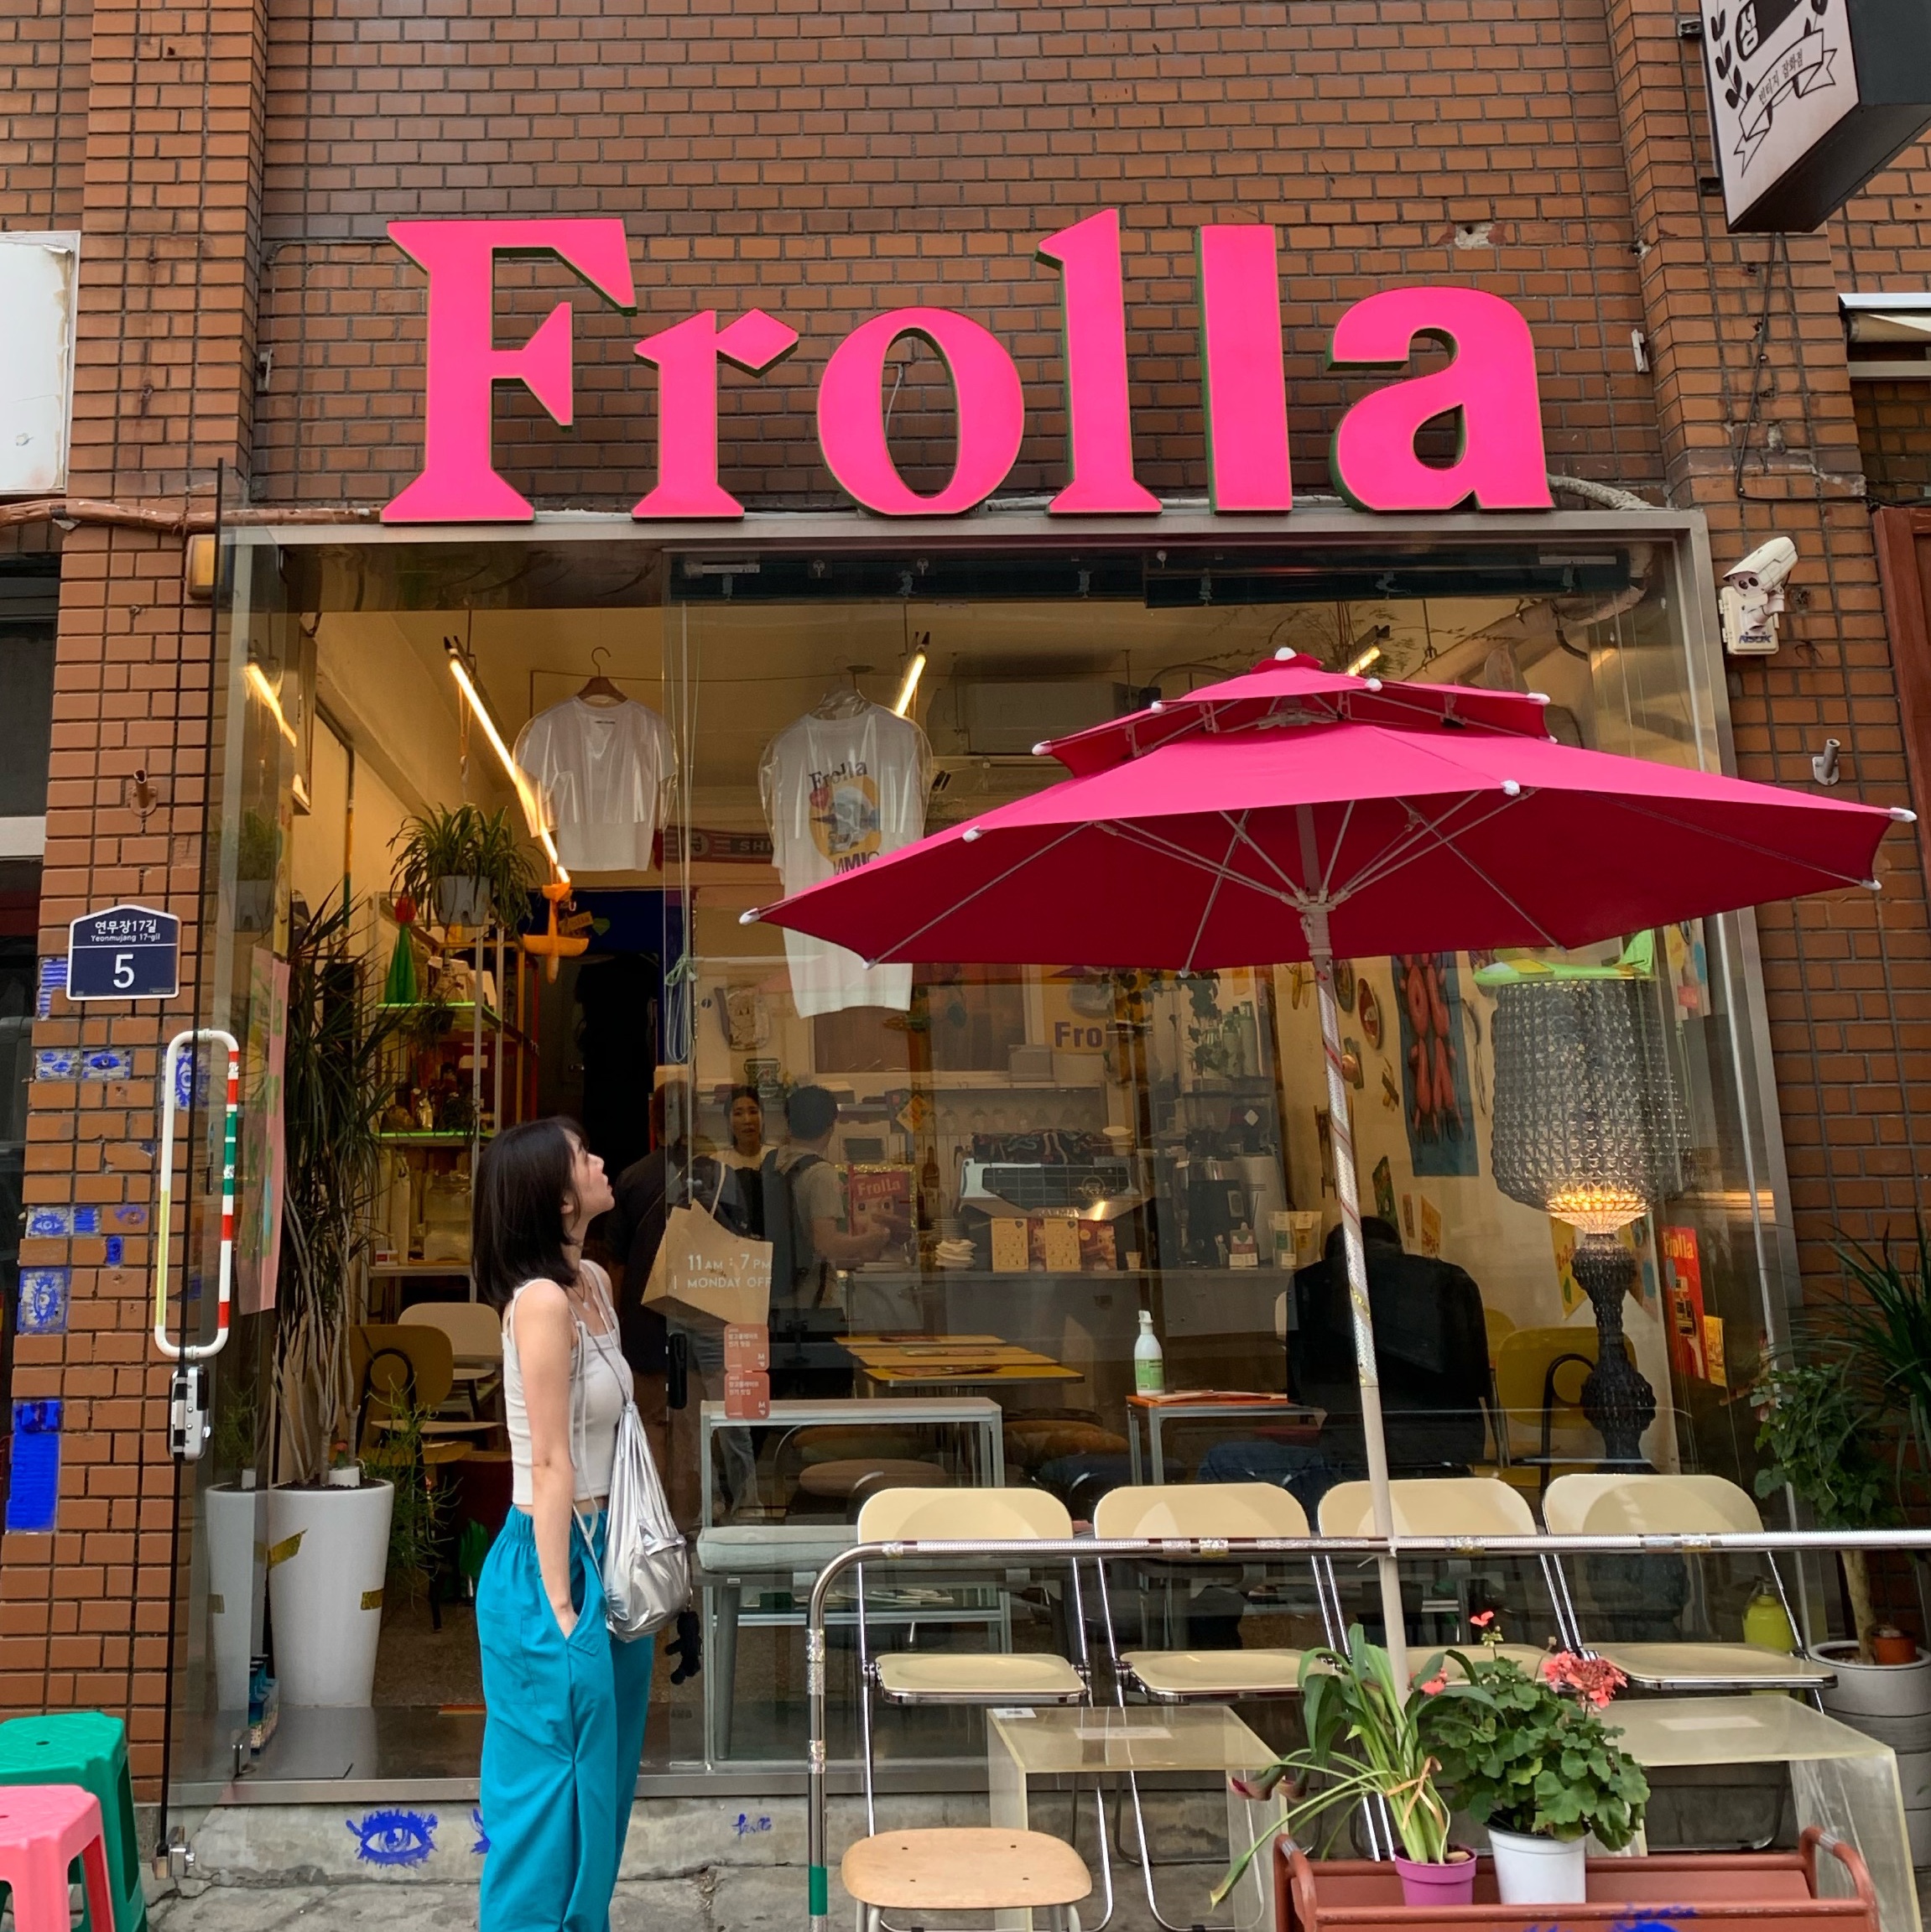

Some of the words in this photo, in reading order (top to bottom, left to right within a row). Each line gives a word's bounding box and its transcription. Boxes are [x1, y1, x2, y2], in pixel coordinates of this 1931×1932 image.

[380, 207, 1555, 524] Frolla
[808, 761, 867, 791] Frolla
[91, 934, 137, 943] Yeonmujang
[139, 933, 161, 942] 17-gil
[95, 919, 157, 935] 연무장17길
[112, 954, 135, 988] 5
[1663, 1232, 1694, 1258] Frolla
[687, 1277, 741, 1289] MONDAY
[747, 1277, 772, 1288] OFF
